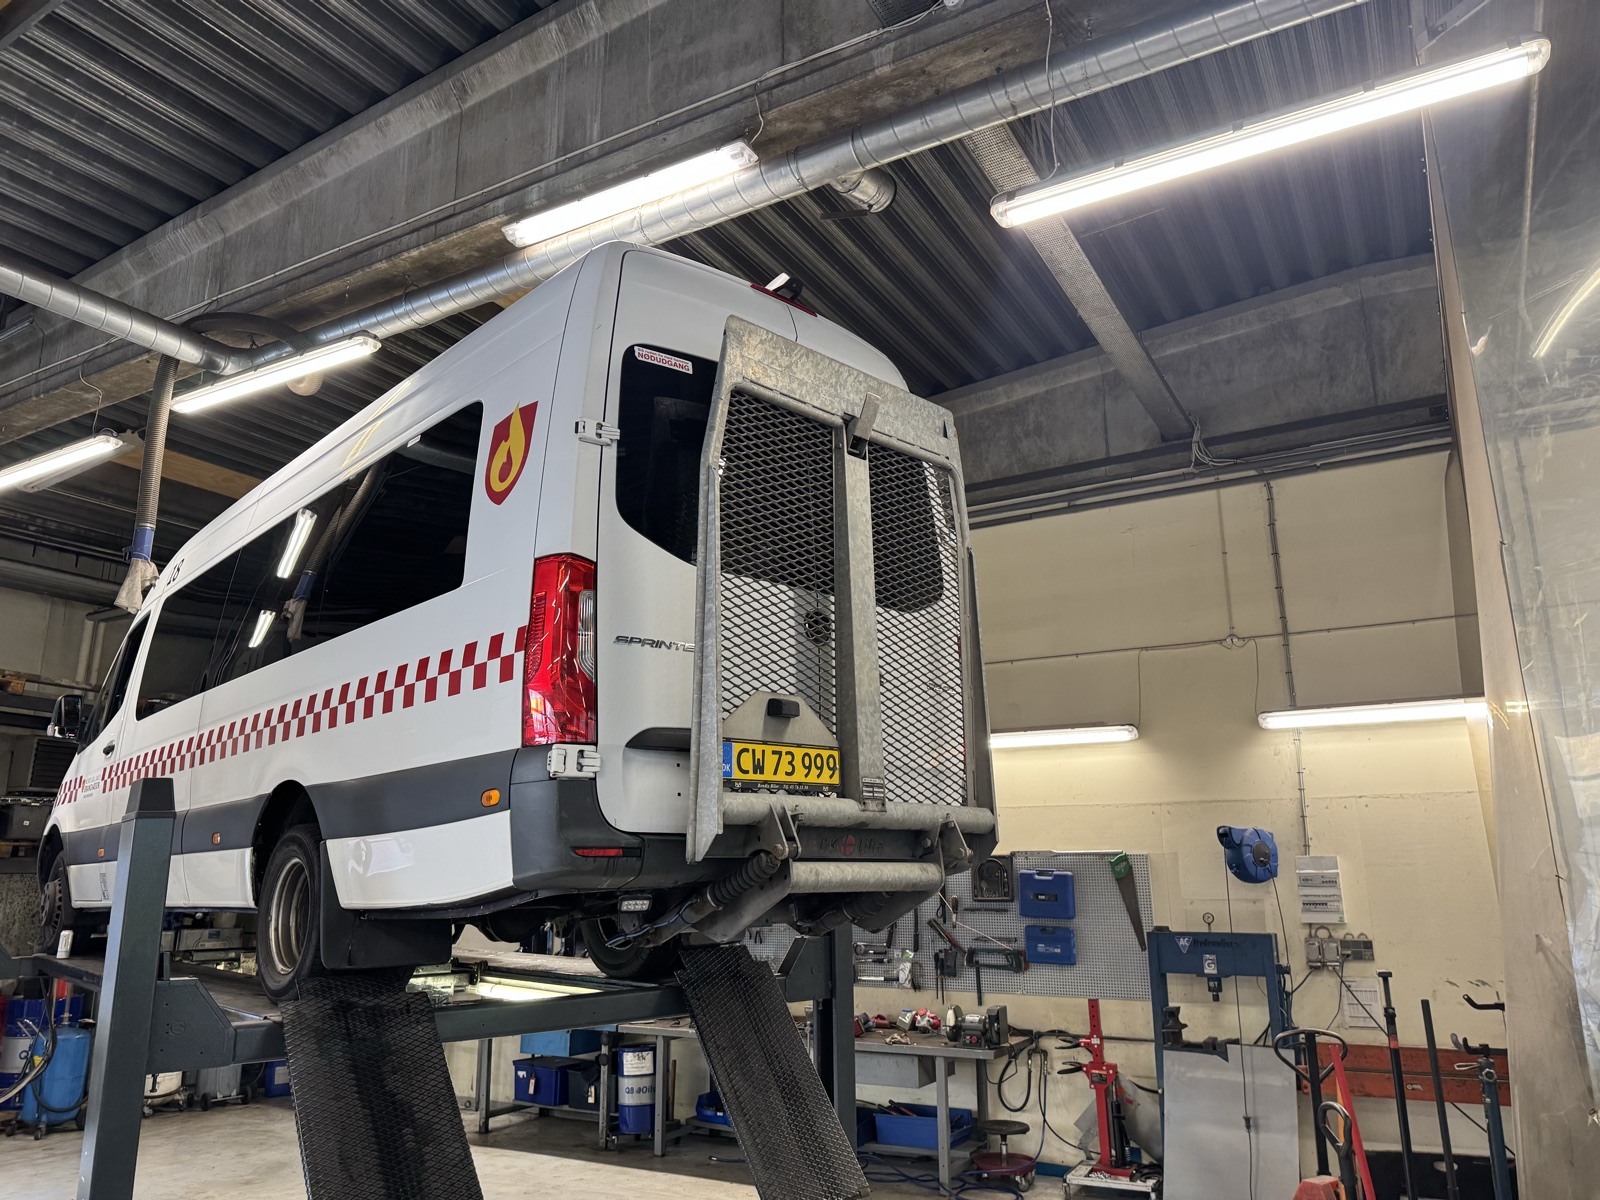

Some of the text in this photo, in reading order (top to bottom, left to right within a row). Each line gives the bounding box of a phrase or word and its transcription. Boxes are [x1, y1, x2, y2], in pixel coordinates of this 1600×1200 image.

[637, 351, 690, 372] NØDUDGANG
[613, 635, 695, 653] SPRINTE
[736, 747, 838, 780] CW 73 999
[1179, 937, 1189, 946] AC
[1205, 960, 1215, 970] G
